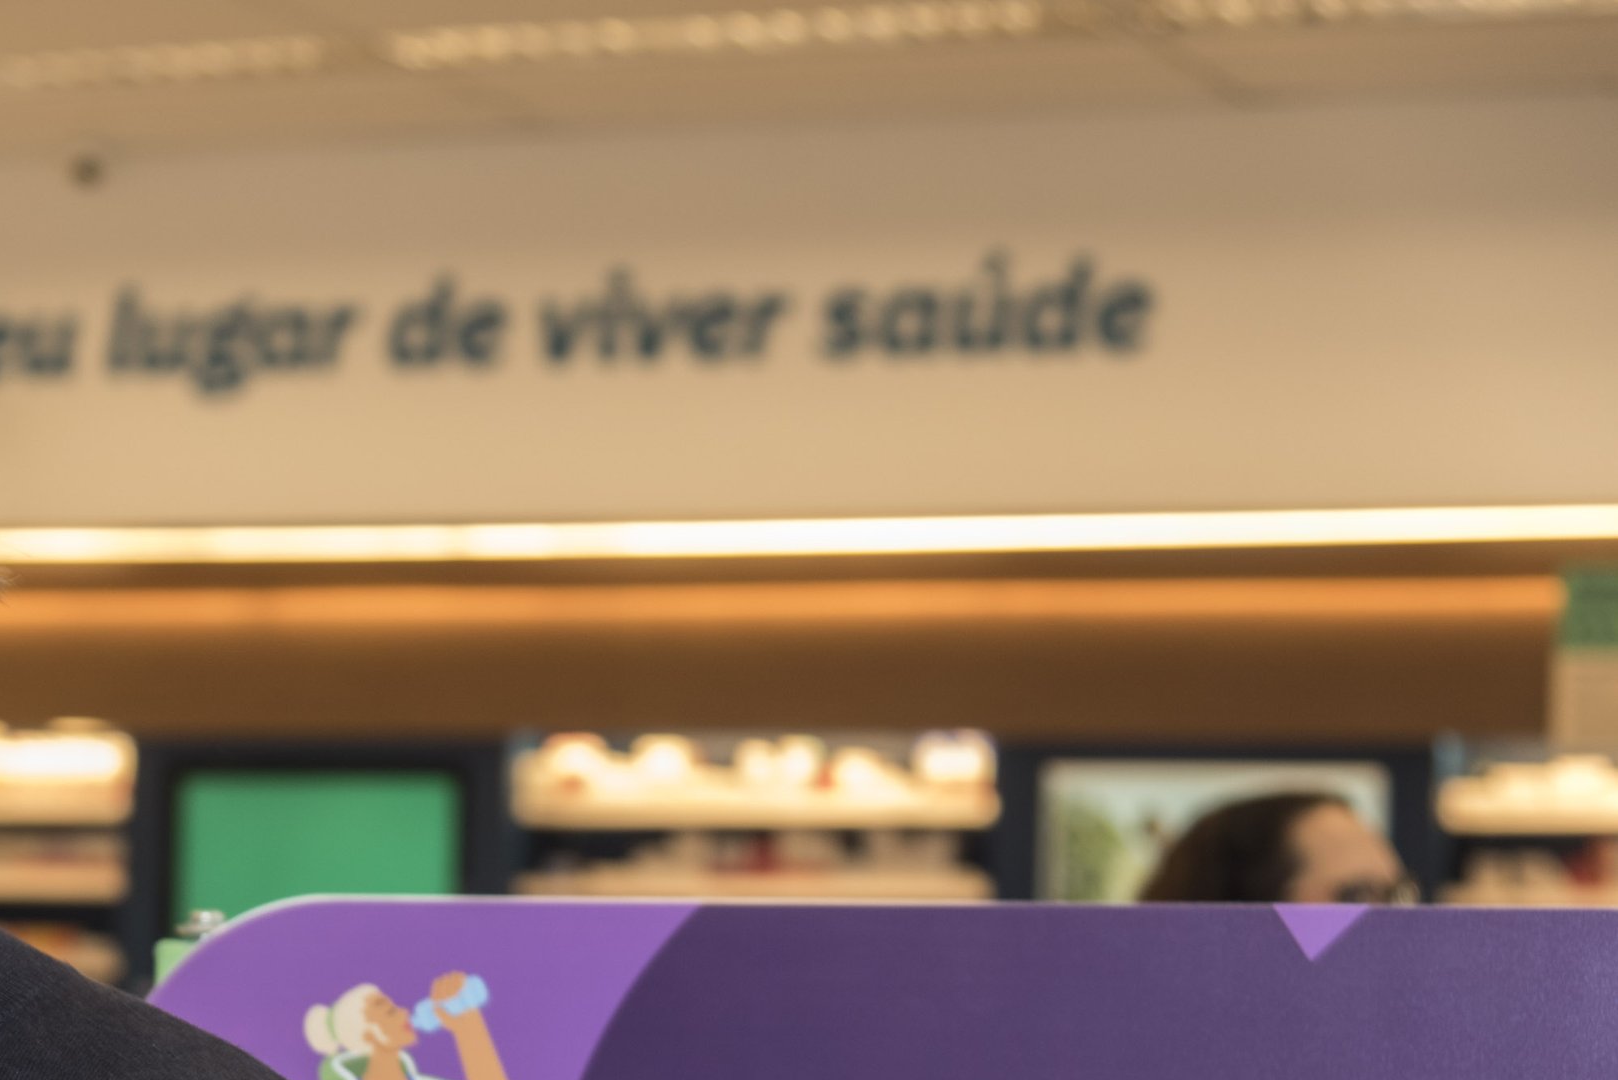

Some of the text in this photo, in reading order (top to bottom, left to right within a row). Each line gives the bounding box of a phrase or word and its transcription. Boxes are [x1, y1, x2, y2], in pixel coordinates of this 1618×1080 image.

[106, 285, 356, 396] lugar
[385, 270, 508, 368] de
[537, 266, 792, 364] viver
[820, 248, 1152, 362] saúde
